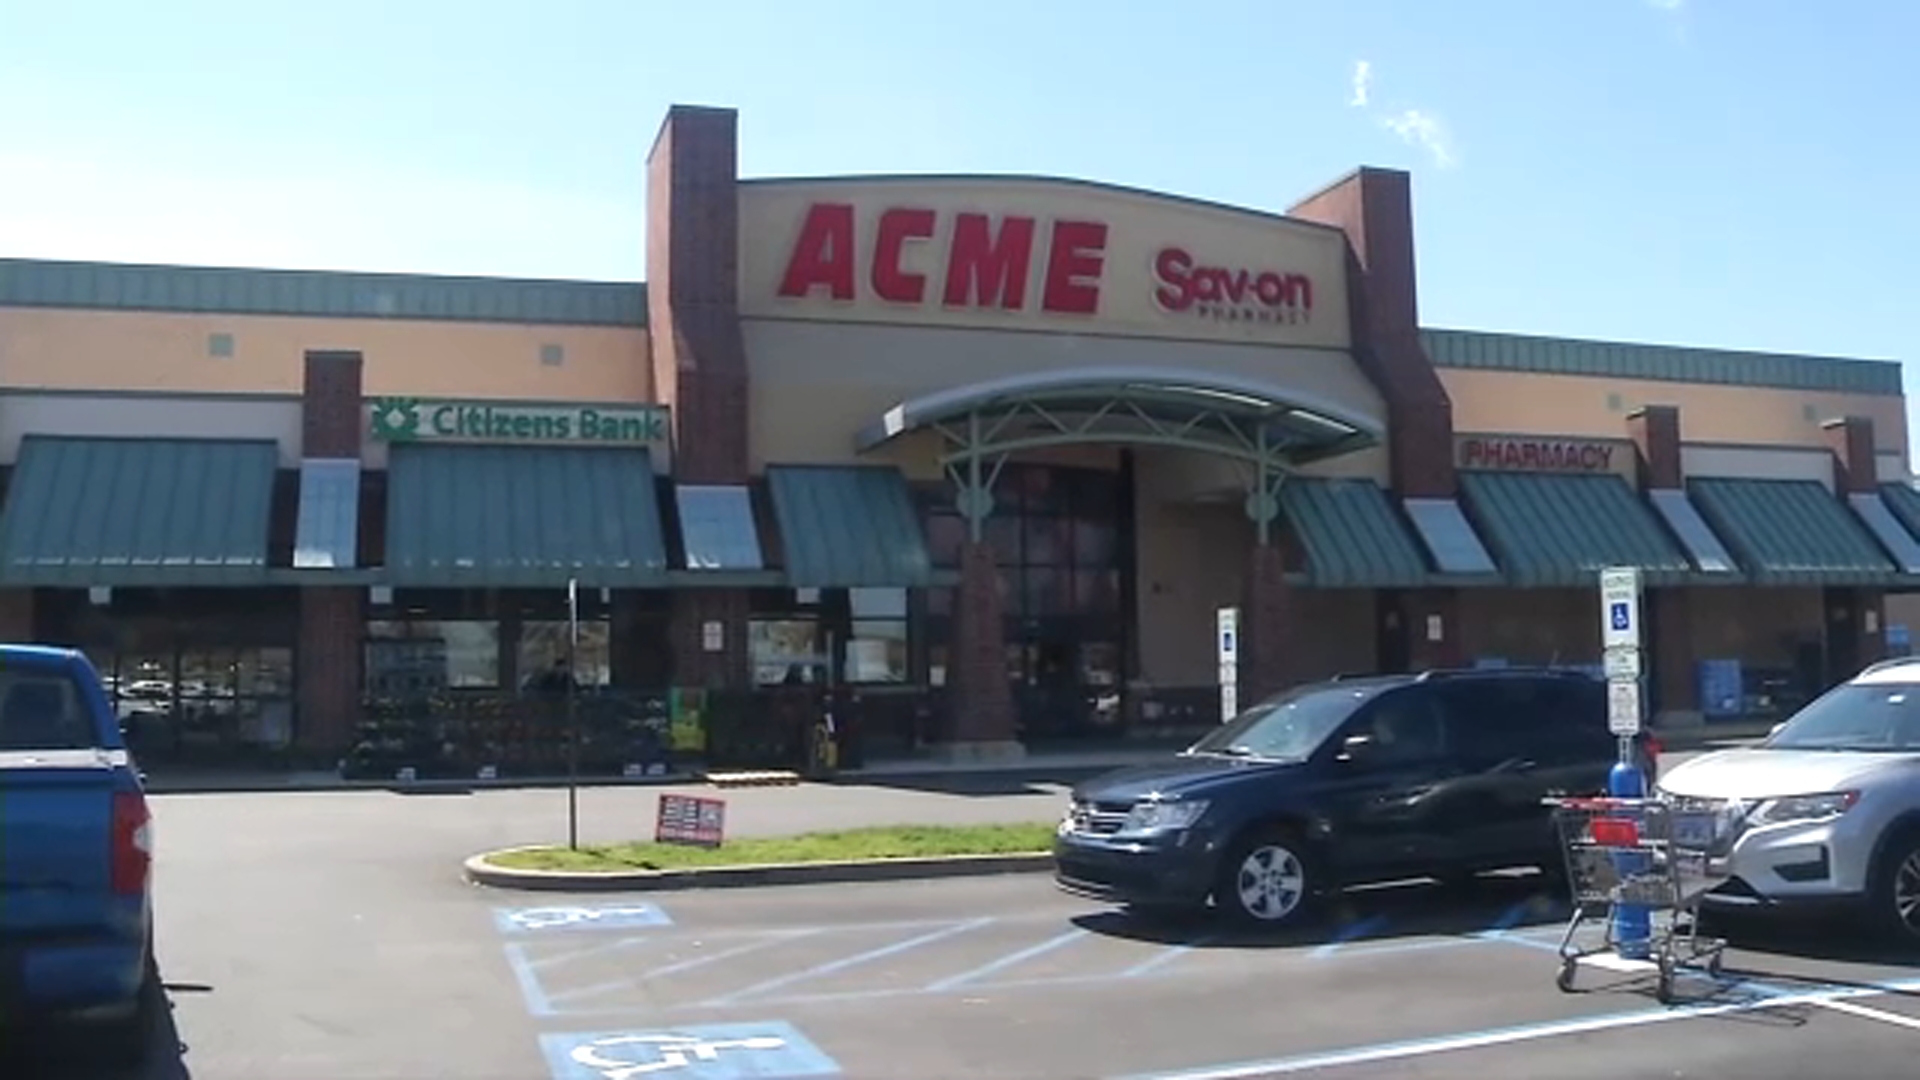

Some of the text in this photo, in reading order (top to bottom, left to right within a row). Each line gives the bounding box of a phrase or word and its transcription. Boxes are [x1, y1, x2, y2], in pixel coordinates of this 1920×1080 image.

[778, 203, 1108, 315] ACME
[1156, 248, 1312, 312] Sav-on
[1199, 305, 1311, 325] PHARMACY
[432, 405, 664, 440] Citizens Bank
[1464, 440, 1613, 469] PHARMACY
